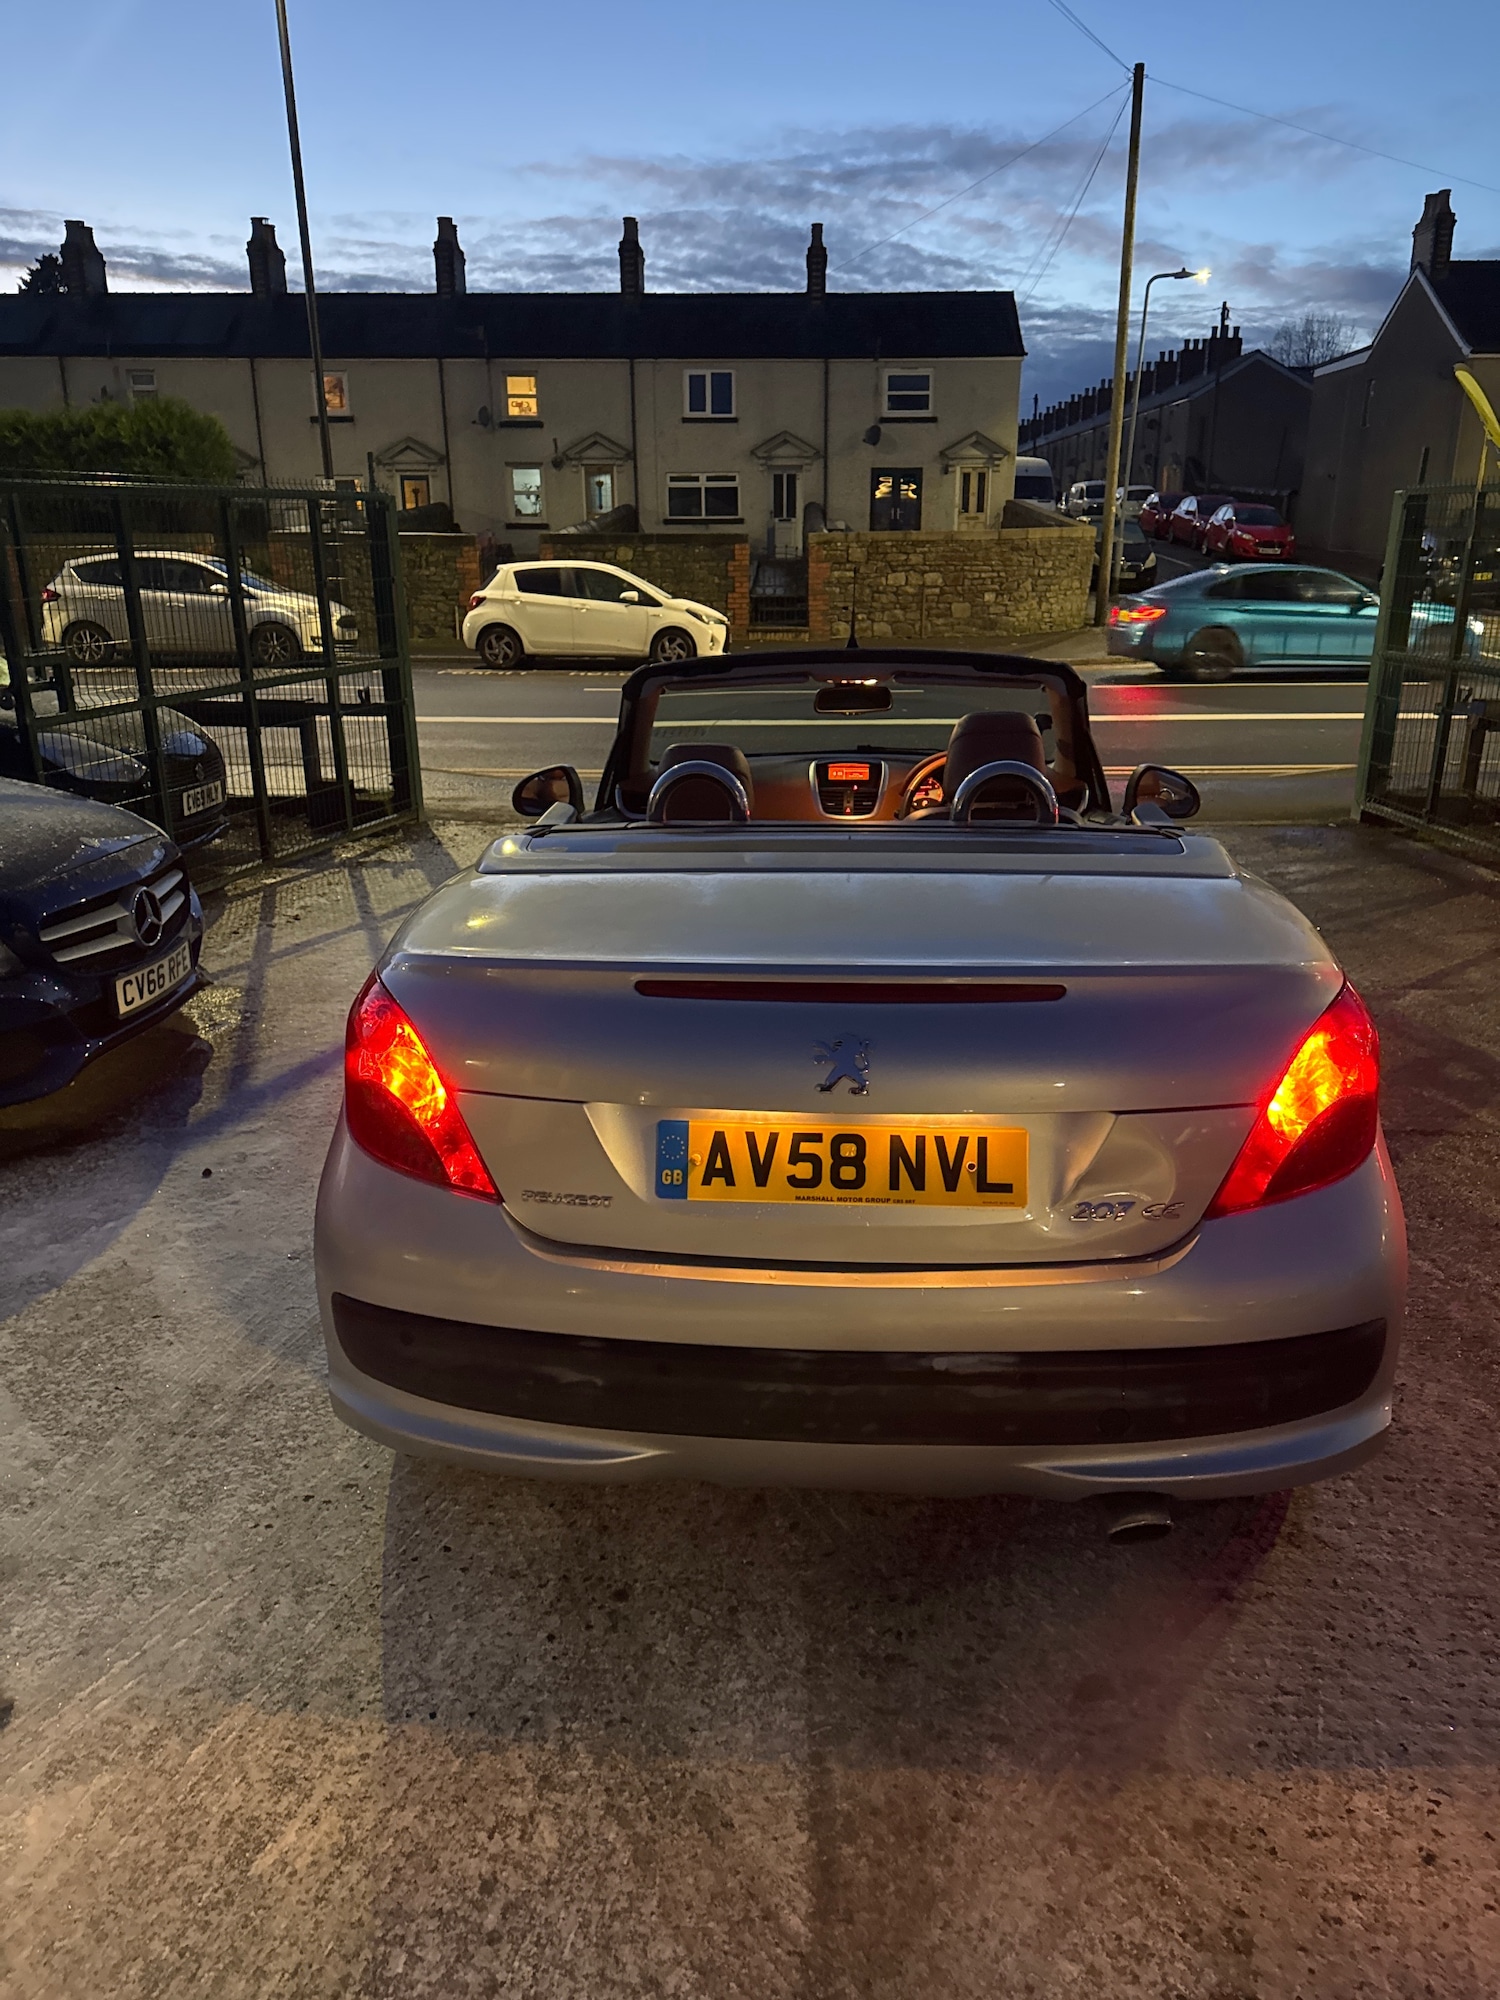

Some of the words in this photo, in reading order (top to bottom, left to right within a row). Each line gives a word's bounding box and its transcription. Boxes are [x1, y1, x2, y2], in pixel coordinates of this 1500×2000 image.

[122, 963, 166, 1007] CV66
[168, 945, 189, 983] RFE
[700, 1130, 867, 1191] AV58
[888, 1134, 1014, 1194] NVL
[661, 1168, 683, 1185] GB
[521, 1189, 613, 1208] PEUGEOT
[1069, 1201, 1137, 1222] 207
